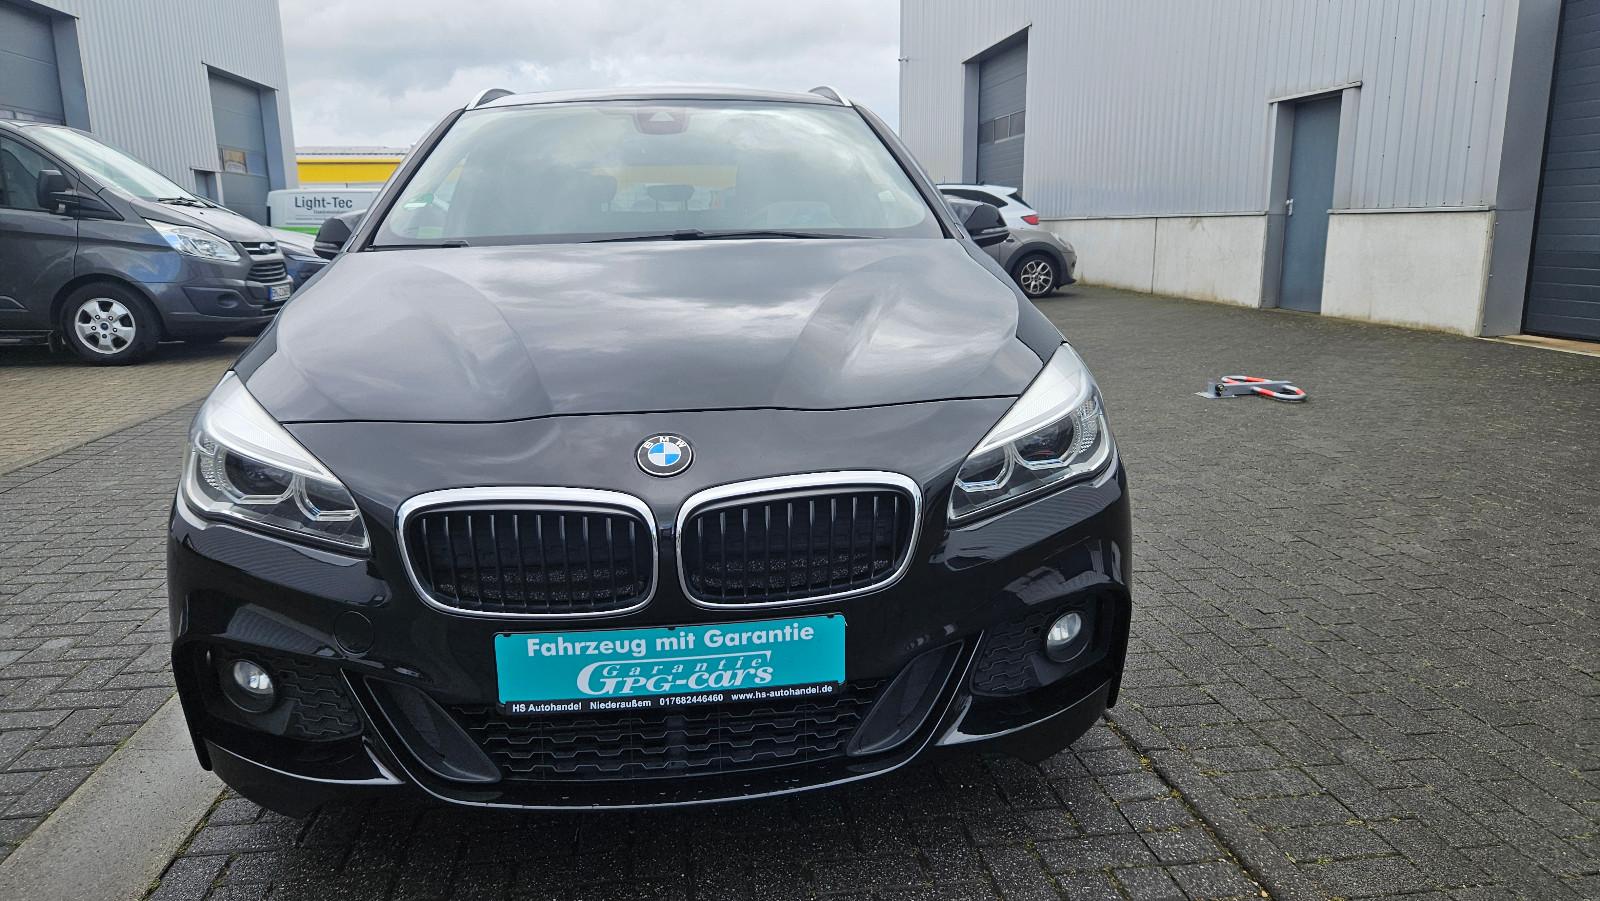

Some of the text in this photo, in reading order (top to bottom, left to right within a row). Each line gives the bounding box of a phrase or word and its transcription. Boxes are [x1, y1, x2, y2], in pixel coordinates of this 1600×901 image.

[294, 196, 353, 210] Light-Tec
[643, 436, 687, 449] BMW
[527, 623, 815, 657] Fahrzeug mit Garantie
[602, 657, 762, 677] Garantie
[512, 685, 833, 712] HS Autohandel Niederaußem 017682446460 www.hs-autohandel.de
